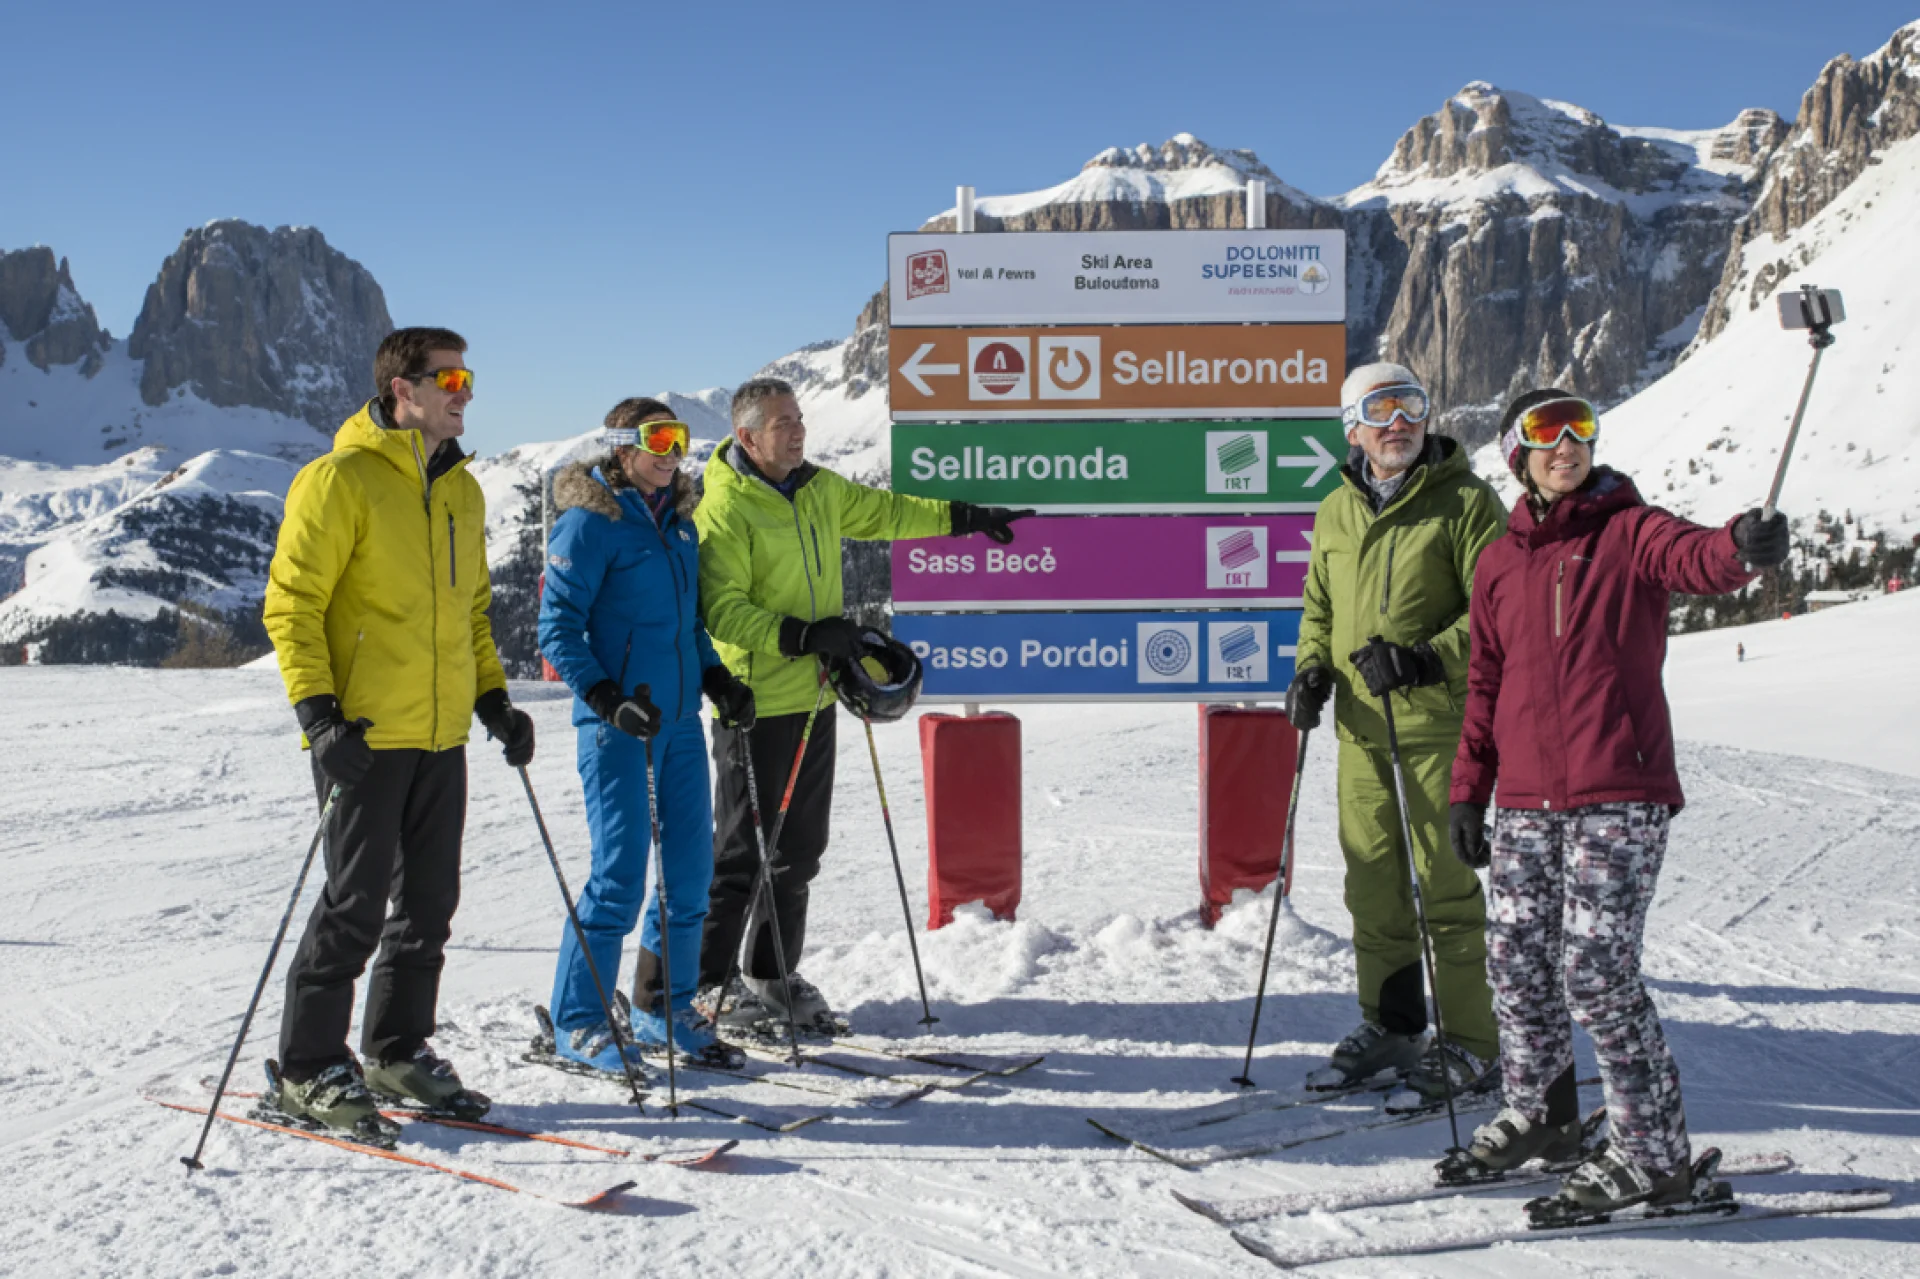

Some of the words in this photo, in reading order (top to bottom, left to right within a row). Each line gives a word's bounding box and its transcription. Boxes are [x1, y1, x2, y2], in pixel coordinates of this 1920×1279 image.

[1113, 255, 1153, 270] Area
[1112, 349, 1328, 385] Sellaronda
[910, 446, 1129, 481] Sellaronda
[908, 548, 976, 573] Sass
[909, 640, 1009, 669] Passo
[1020, 638, 1129, 668] Pordoi
